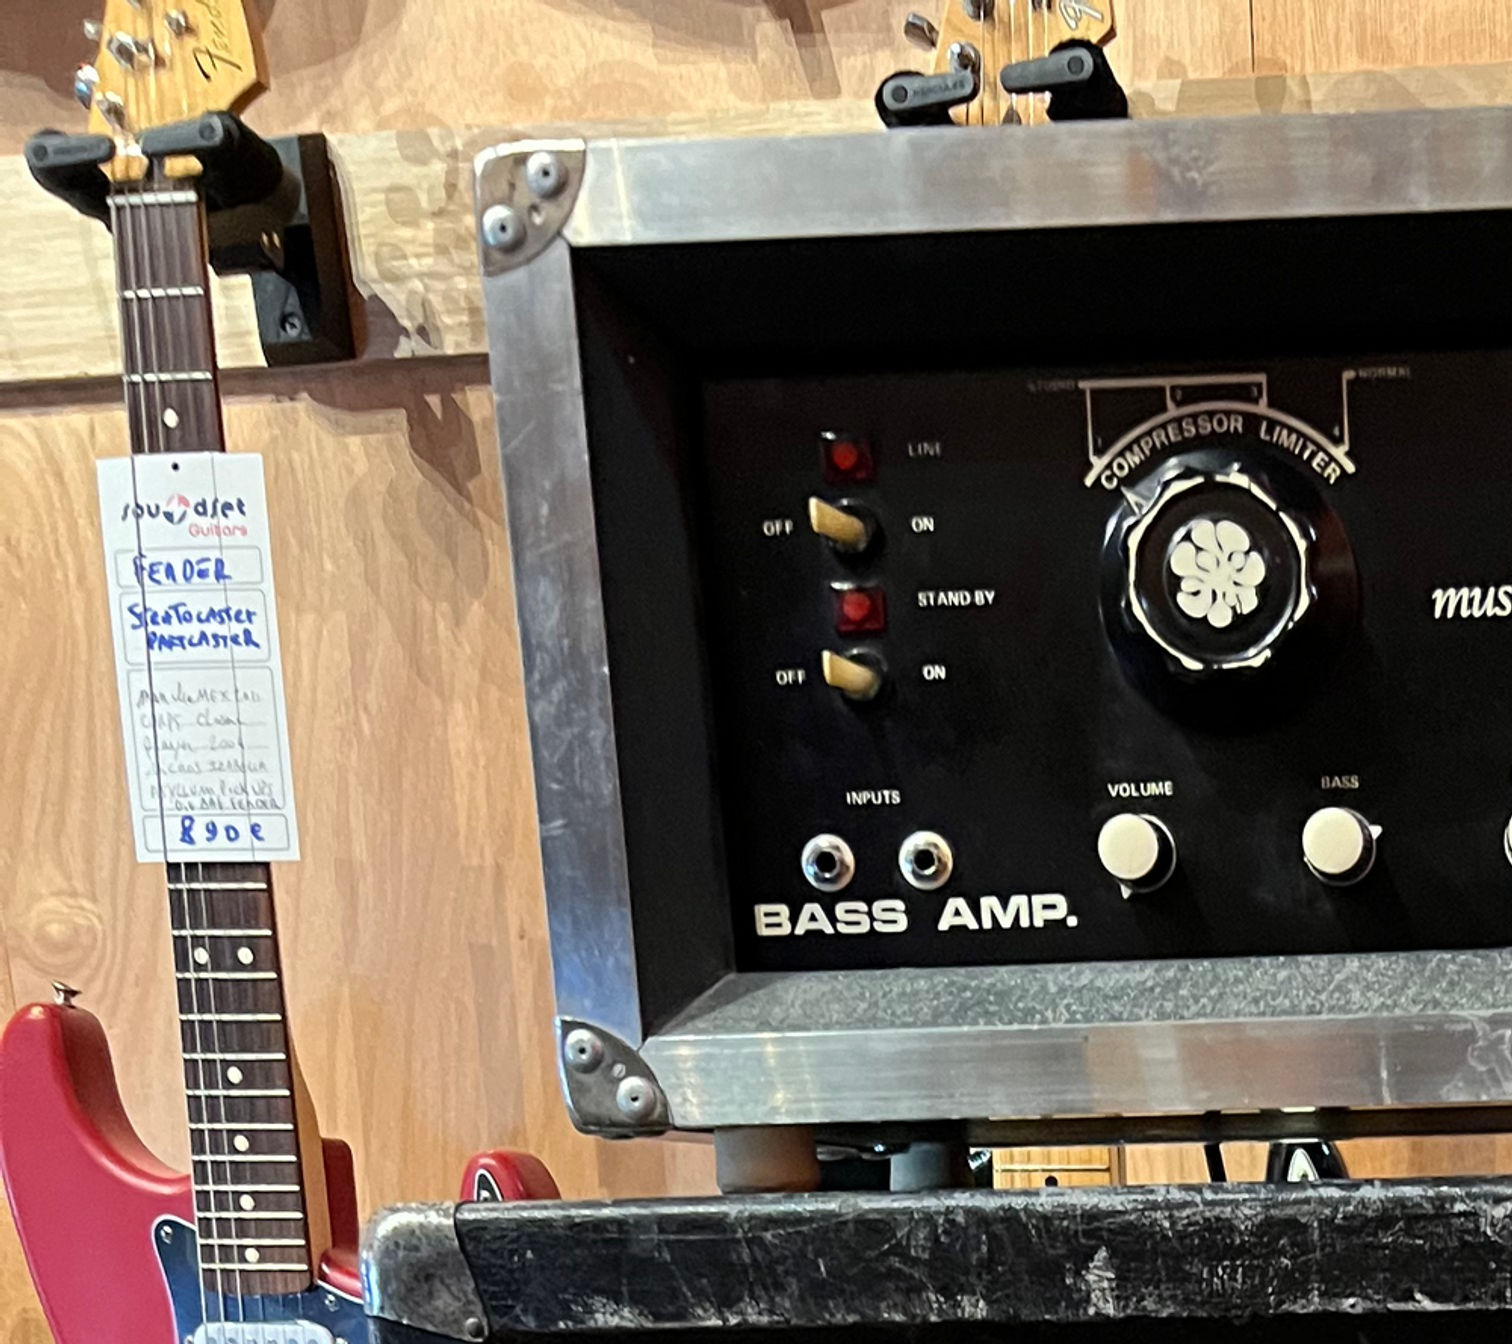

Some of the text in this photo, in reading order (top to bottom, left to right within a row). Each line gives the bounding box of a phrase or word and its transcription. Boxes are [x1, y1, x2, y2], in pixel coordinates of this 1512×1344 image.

[1100, 413, 1340, 490] COMPRESSOR LIMITER
[762, 519, 794, 536] OFF
[911, 516, 935, 532] ON
[776, 669, 806, 686] OFF
[922, 664, 946, 681] ON
[1107, 780, 1174, 798] VOLUME
[1320, 774, 1360, 790] BASS
[846, 790, 901, 806] INPUTS
[754, 893, 1079, 937] BASS AMP.
